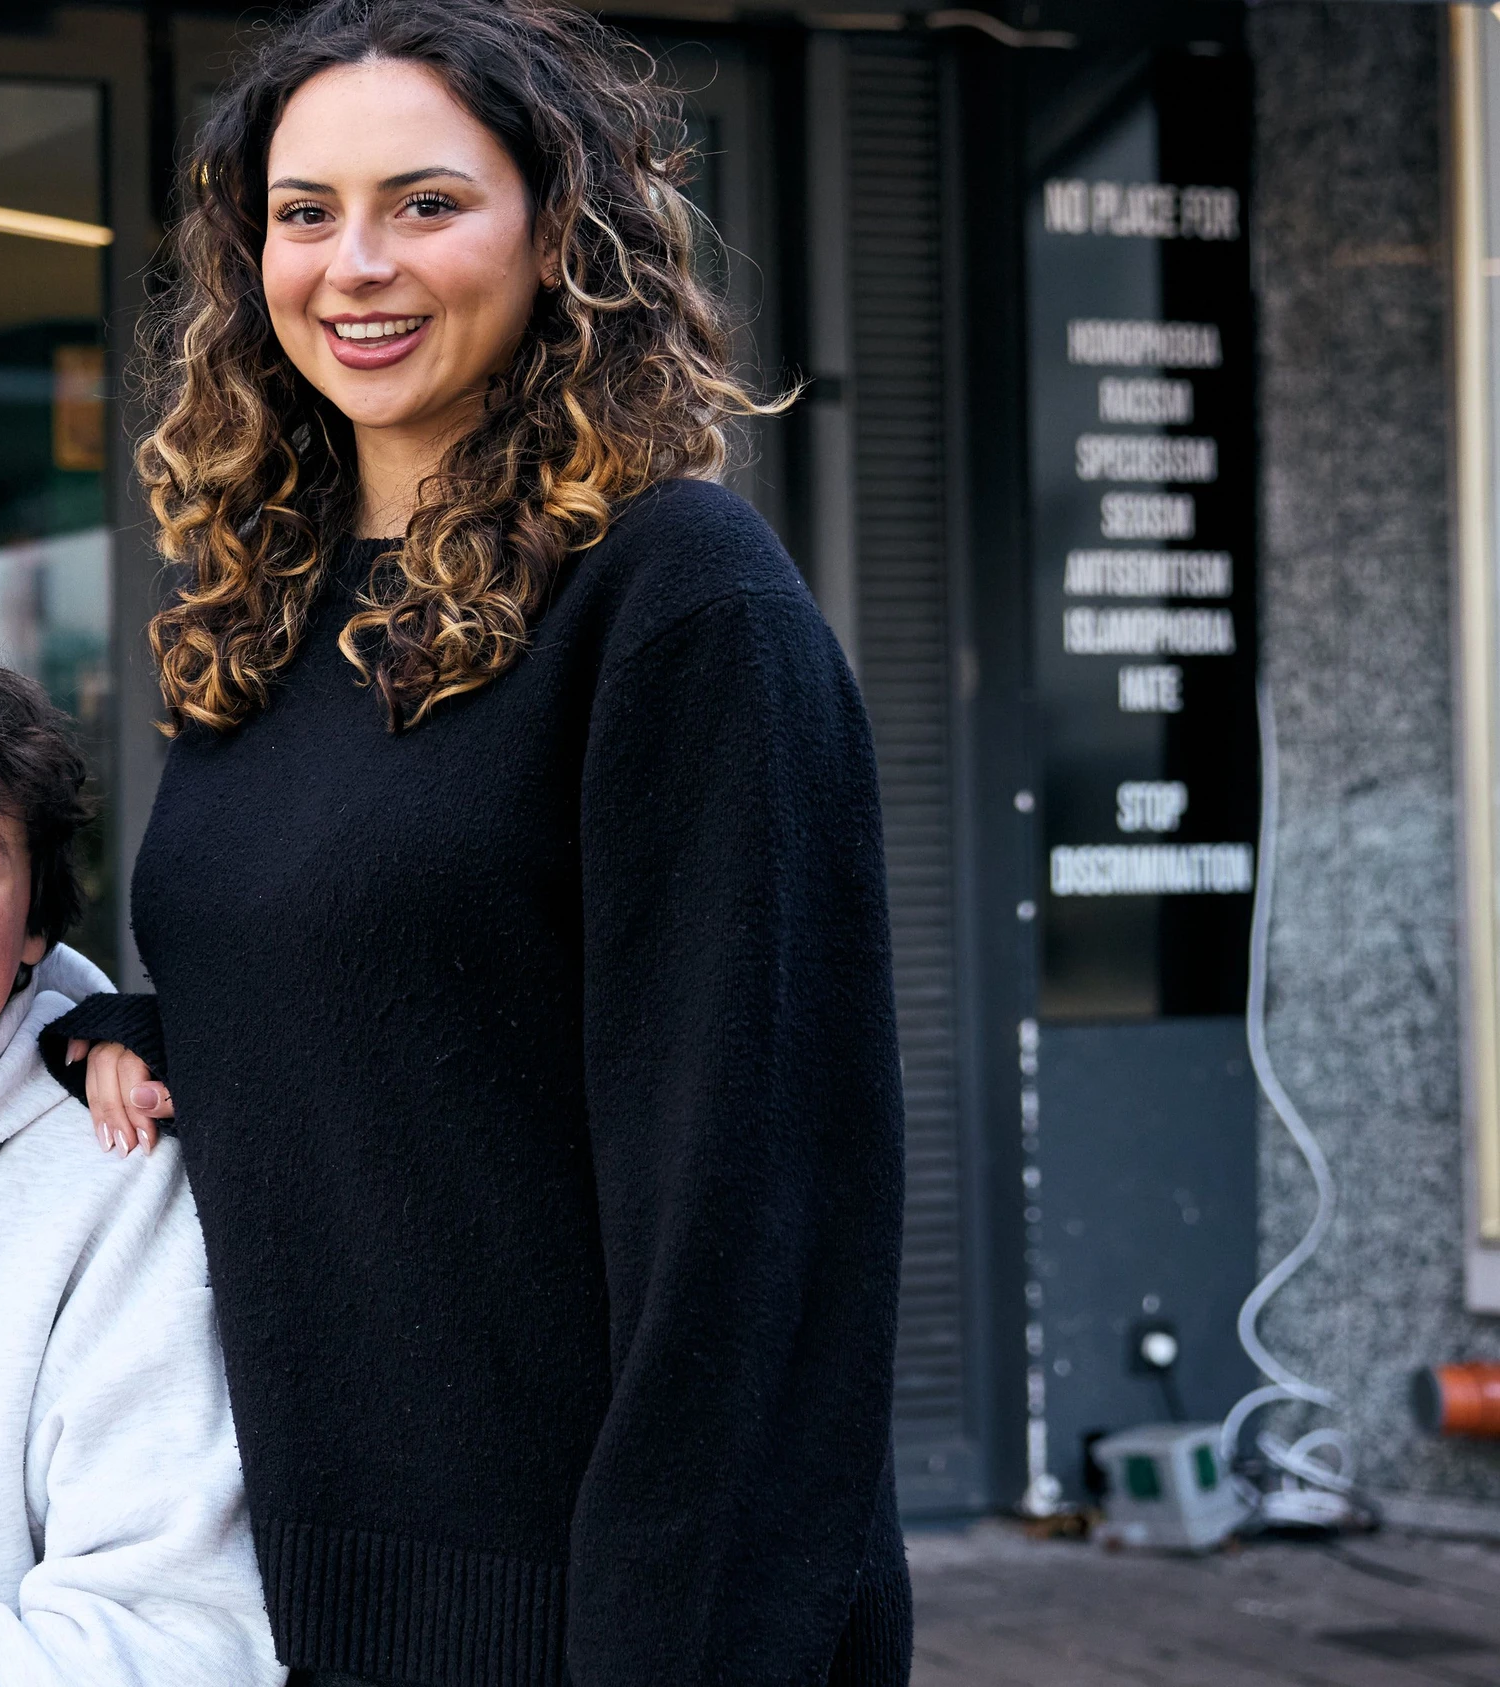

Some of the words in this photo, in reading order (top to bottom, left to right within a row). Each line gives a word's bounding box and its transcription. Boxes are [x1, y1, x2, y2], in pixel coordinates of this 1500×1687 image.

[1046, 180, 1086, 233] NO
[1091, 182, 1175, 236] PLACE
[1180, 186, 1239, 239] FOR
[1068, 320, 1221, 366] HOMOPHOBIA
[1100, 377, 1192, 423] RACISM
[1101, 492, 1194, 538] SEXISM
[1064, 551, 1232, 595] ANTISEMITISM
[1063, 608, 1234, 653] ISLAMOPHOBIA
[1118, 666, 1182, 711] HATE
[1116, 781, 1186, 831] STOP
[1051, 844, 1251, 895] DISCRIMINATION
